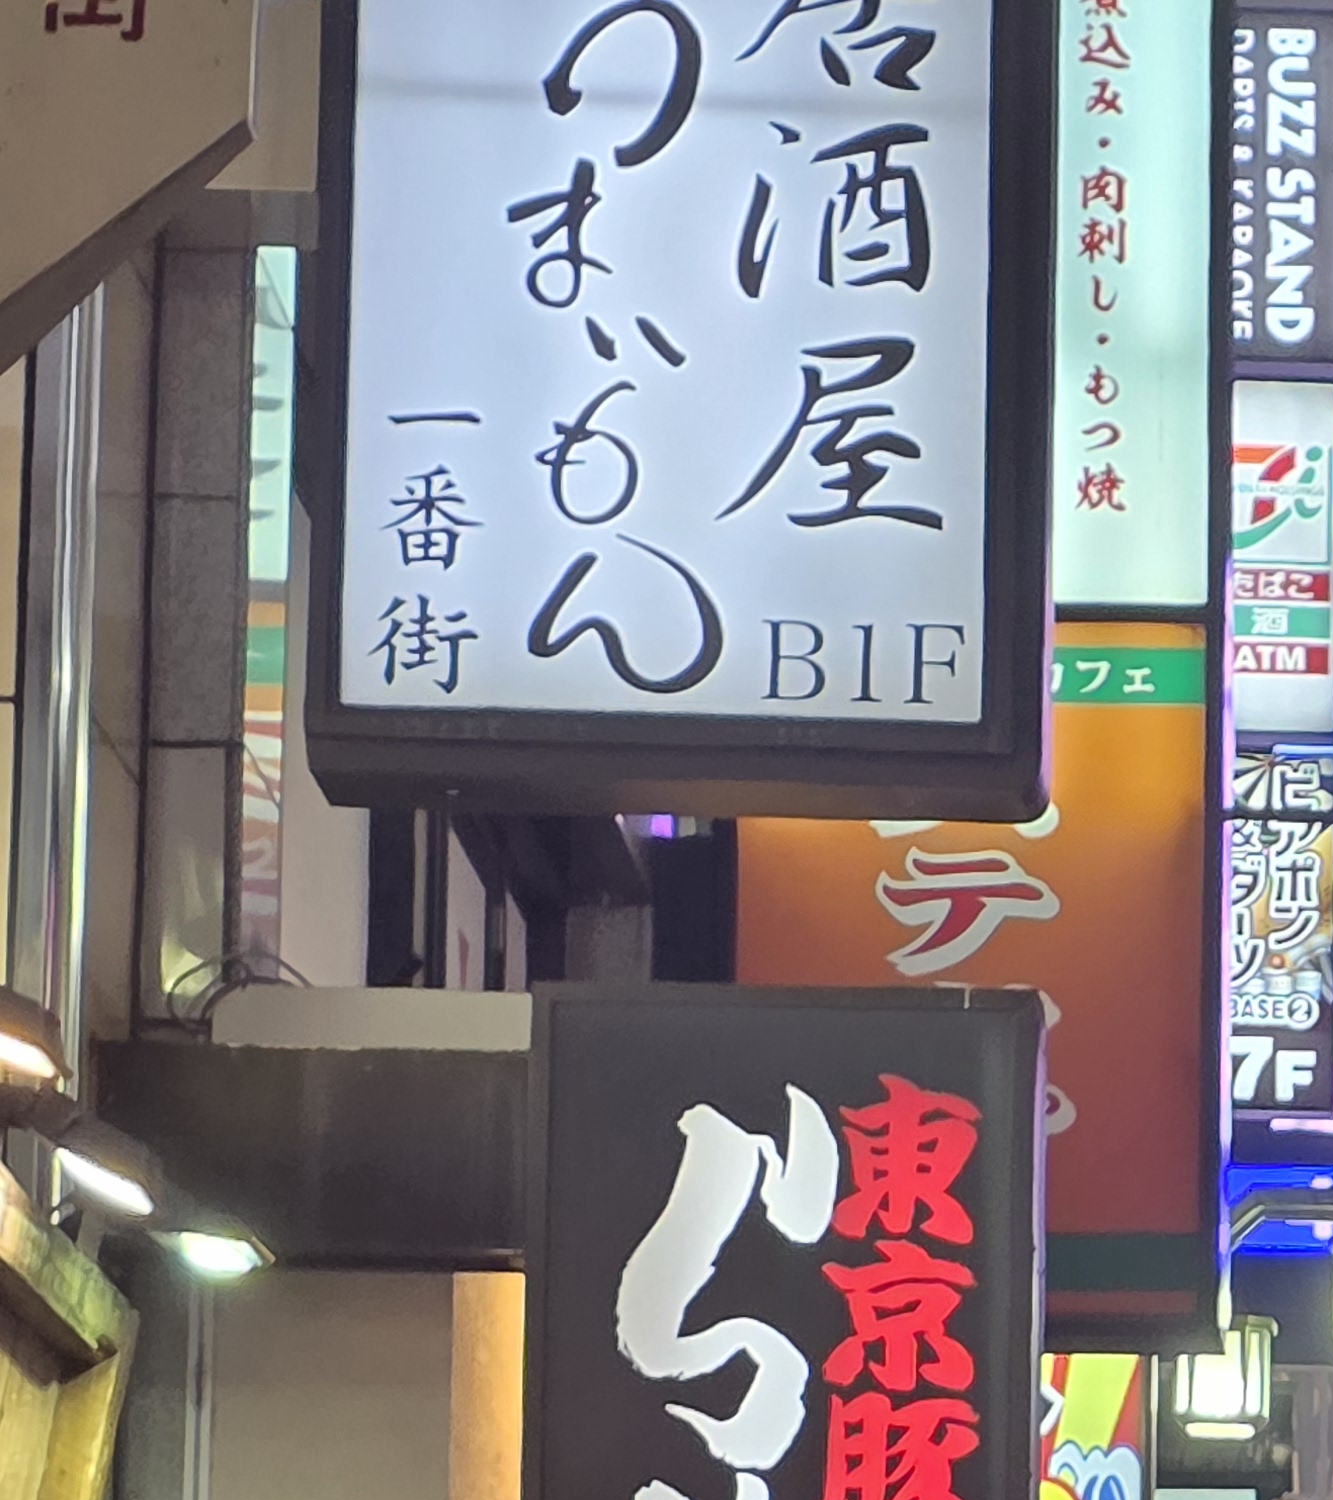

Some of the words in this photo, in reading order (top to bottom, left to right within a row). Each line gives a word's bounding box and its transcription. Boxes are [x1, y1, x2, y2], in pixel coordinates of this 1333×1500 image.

[1266, 27, 1316, 156] BUZZ
[1265, 167, 1316, 345] STAND
[367, 410, 485, 694] 一番街
[761, 619, 966, 704] B1F
[1233, 646, 1307, 672] ATM
[1230, 1036, 1317, 1102] 7F
